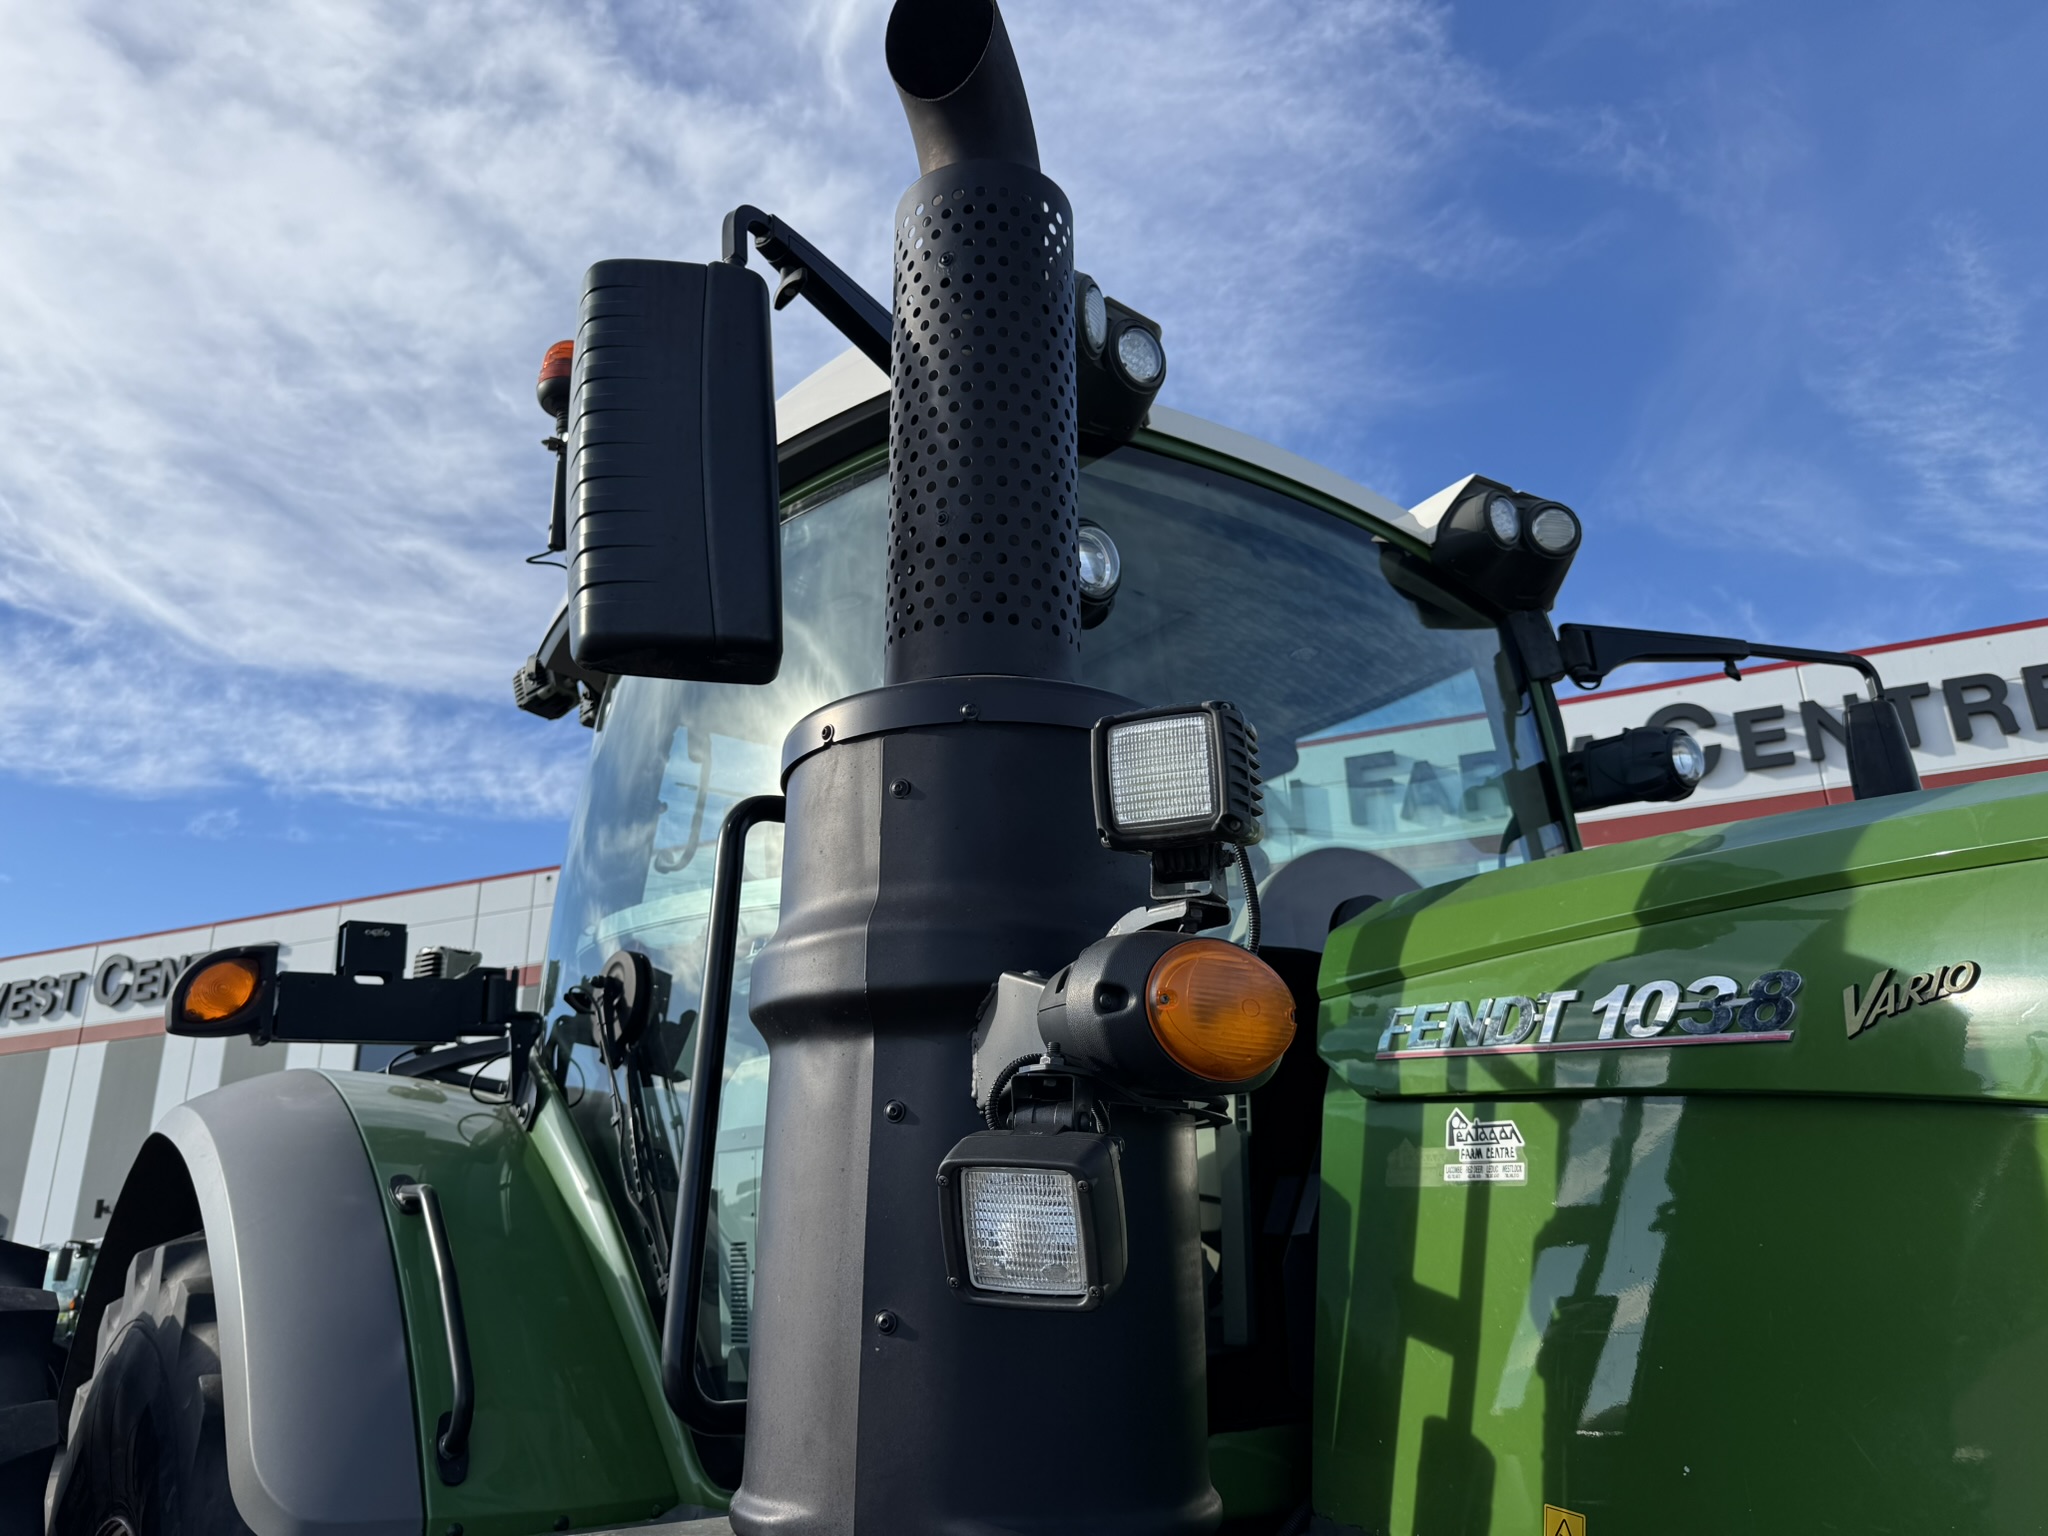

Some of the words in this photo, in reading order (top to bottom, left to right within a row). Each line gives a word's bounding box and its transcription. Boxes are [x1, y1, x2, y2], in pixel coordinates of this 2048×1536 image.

[1377, 990, 1582, 1051] FENDT
[1592, 969, 1803, 1040] 1038
[1842, 960, 1981, 1040] VARIO
[1460, 1147, 1483, 1159] FARM
[1485, 1147, 1515, 1159] CENTRE
